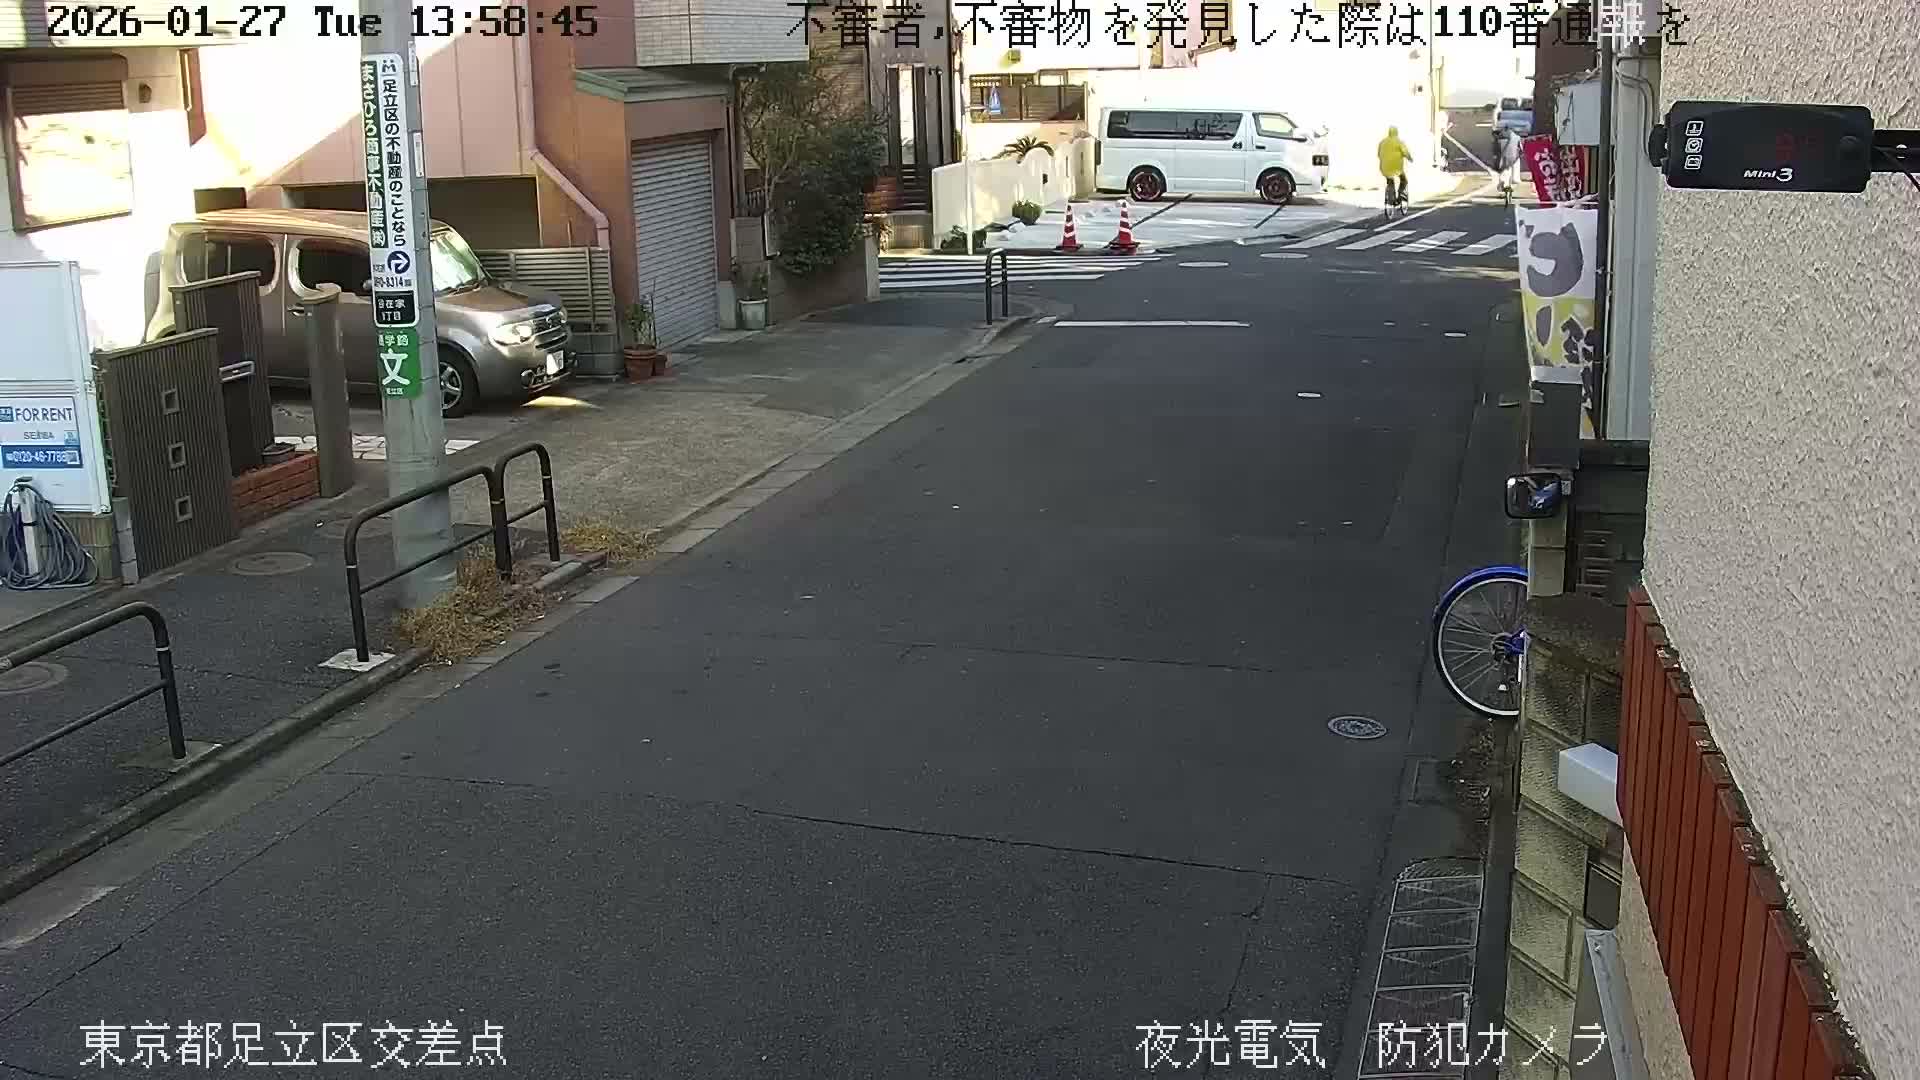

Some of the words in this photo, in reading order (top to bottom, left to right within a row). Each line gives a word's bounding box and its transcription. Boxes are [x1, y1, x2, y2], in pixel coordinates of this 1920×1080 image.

[382, 79, 406, 247] 足立区の不動産のことなら
[380, 348, 411, 386] 文
[15, 407, 39, 422] FOR
[41, 407, 73, 422] RENT
